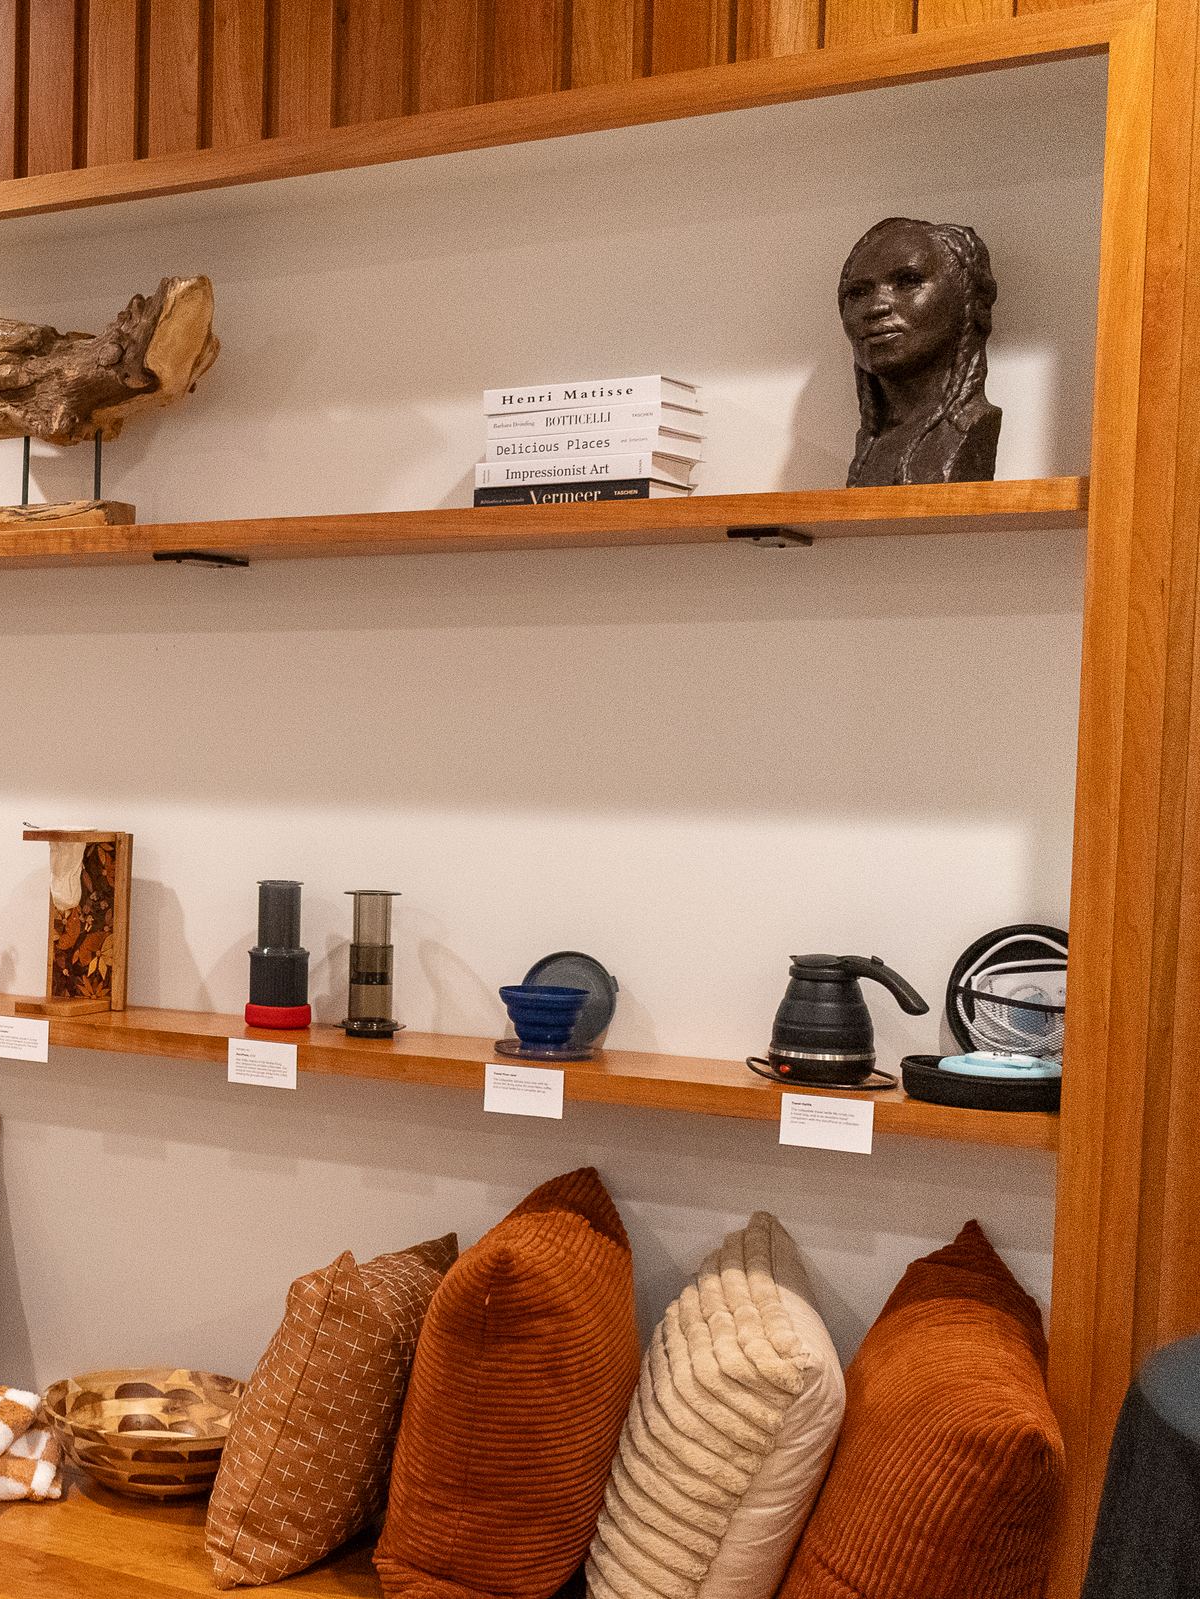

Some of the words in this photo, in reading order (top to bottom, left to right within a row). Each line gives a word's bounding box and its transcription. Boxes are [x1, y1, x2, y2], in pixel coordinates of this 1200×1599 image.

[501, 391, 552, 406] Henri
[563, 386, 634, 401] Matisse
[544, 411, 611, 428] BOTTICELLI
[496, 442, 560, 456] Delicious
[567, 438, 611, 450] Places
[505, 464, 587, 482] Impressionist
[589, 463, 610, 475] Art
[529, 490, 601, 504] Vermeer
